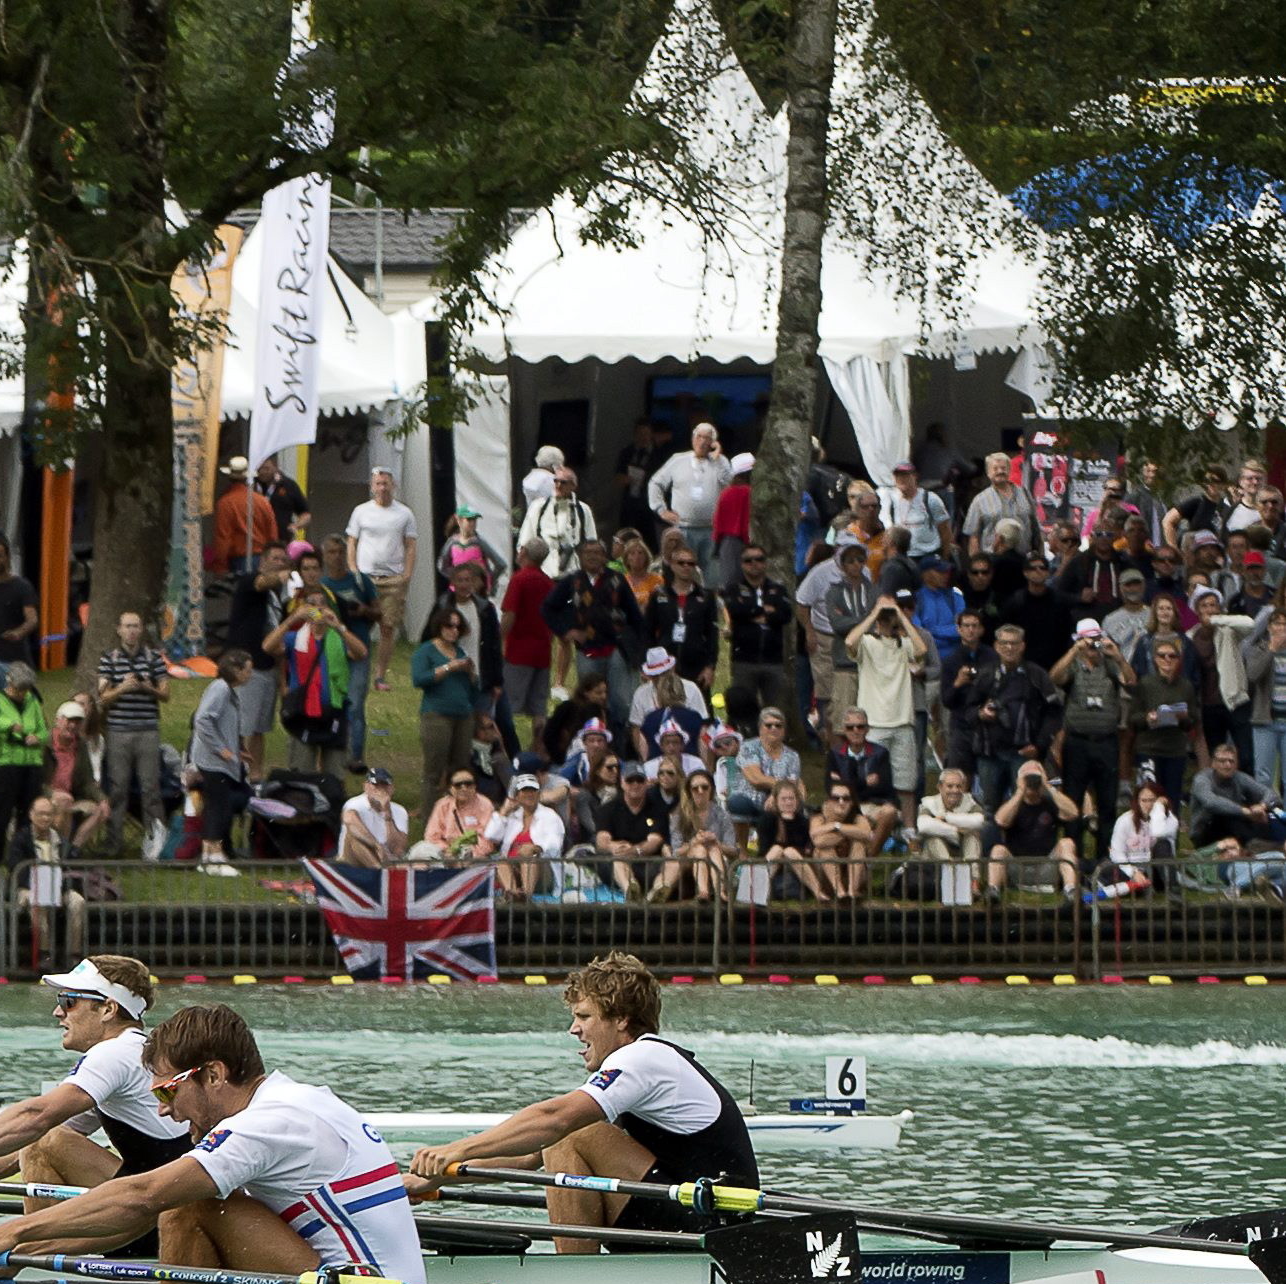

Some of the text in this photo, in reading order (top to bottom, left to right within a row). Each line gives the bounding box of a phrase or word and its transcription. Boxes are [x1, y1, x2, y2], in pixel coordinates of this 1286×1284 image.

[264, 302, 317, 415] Swift
[838, 1057, 857, 1097] 6
[171, 1271, 219, 1283] concept
[220, 1275, 228, 1284] 2
[860, 1262, 966, 1280] world rowing
